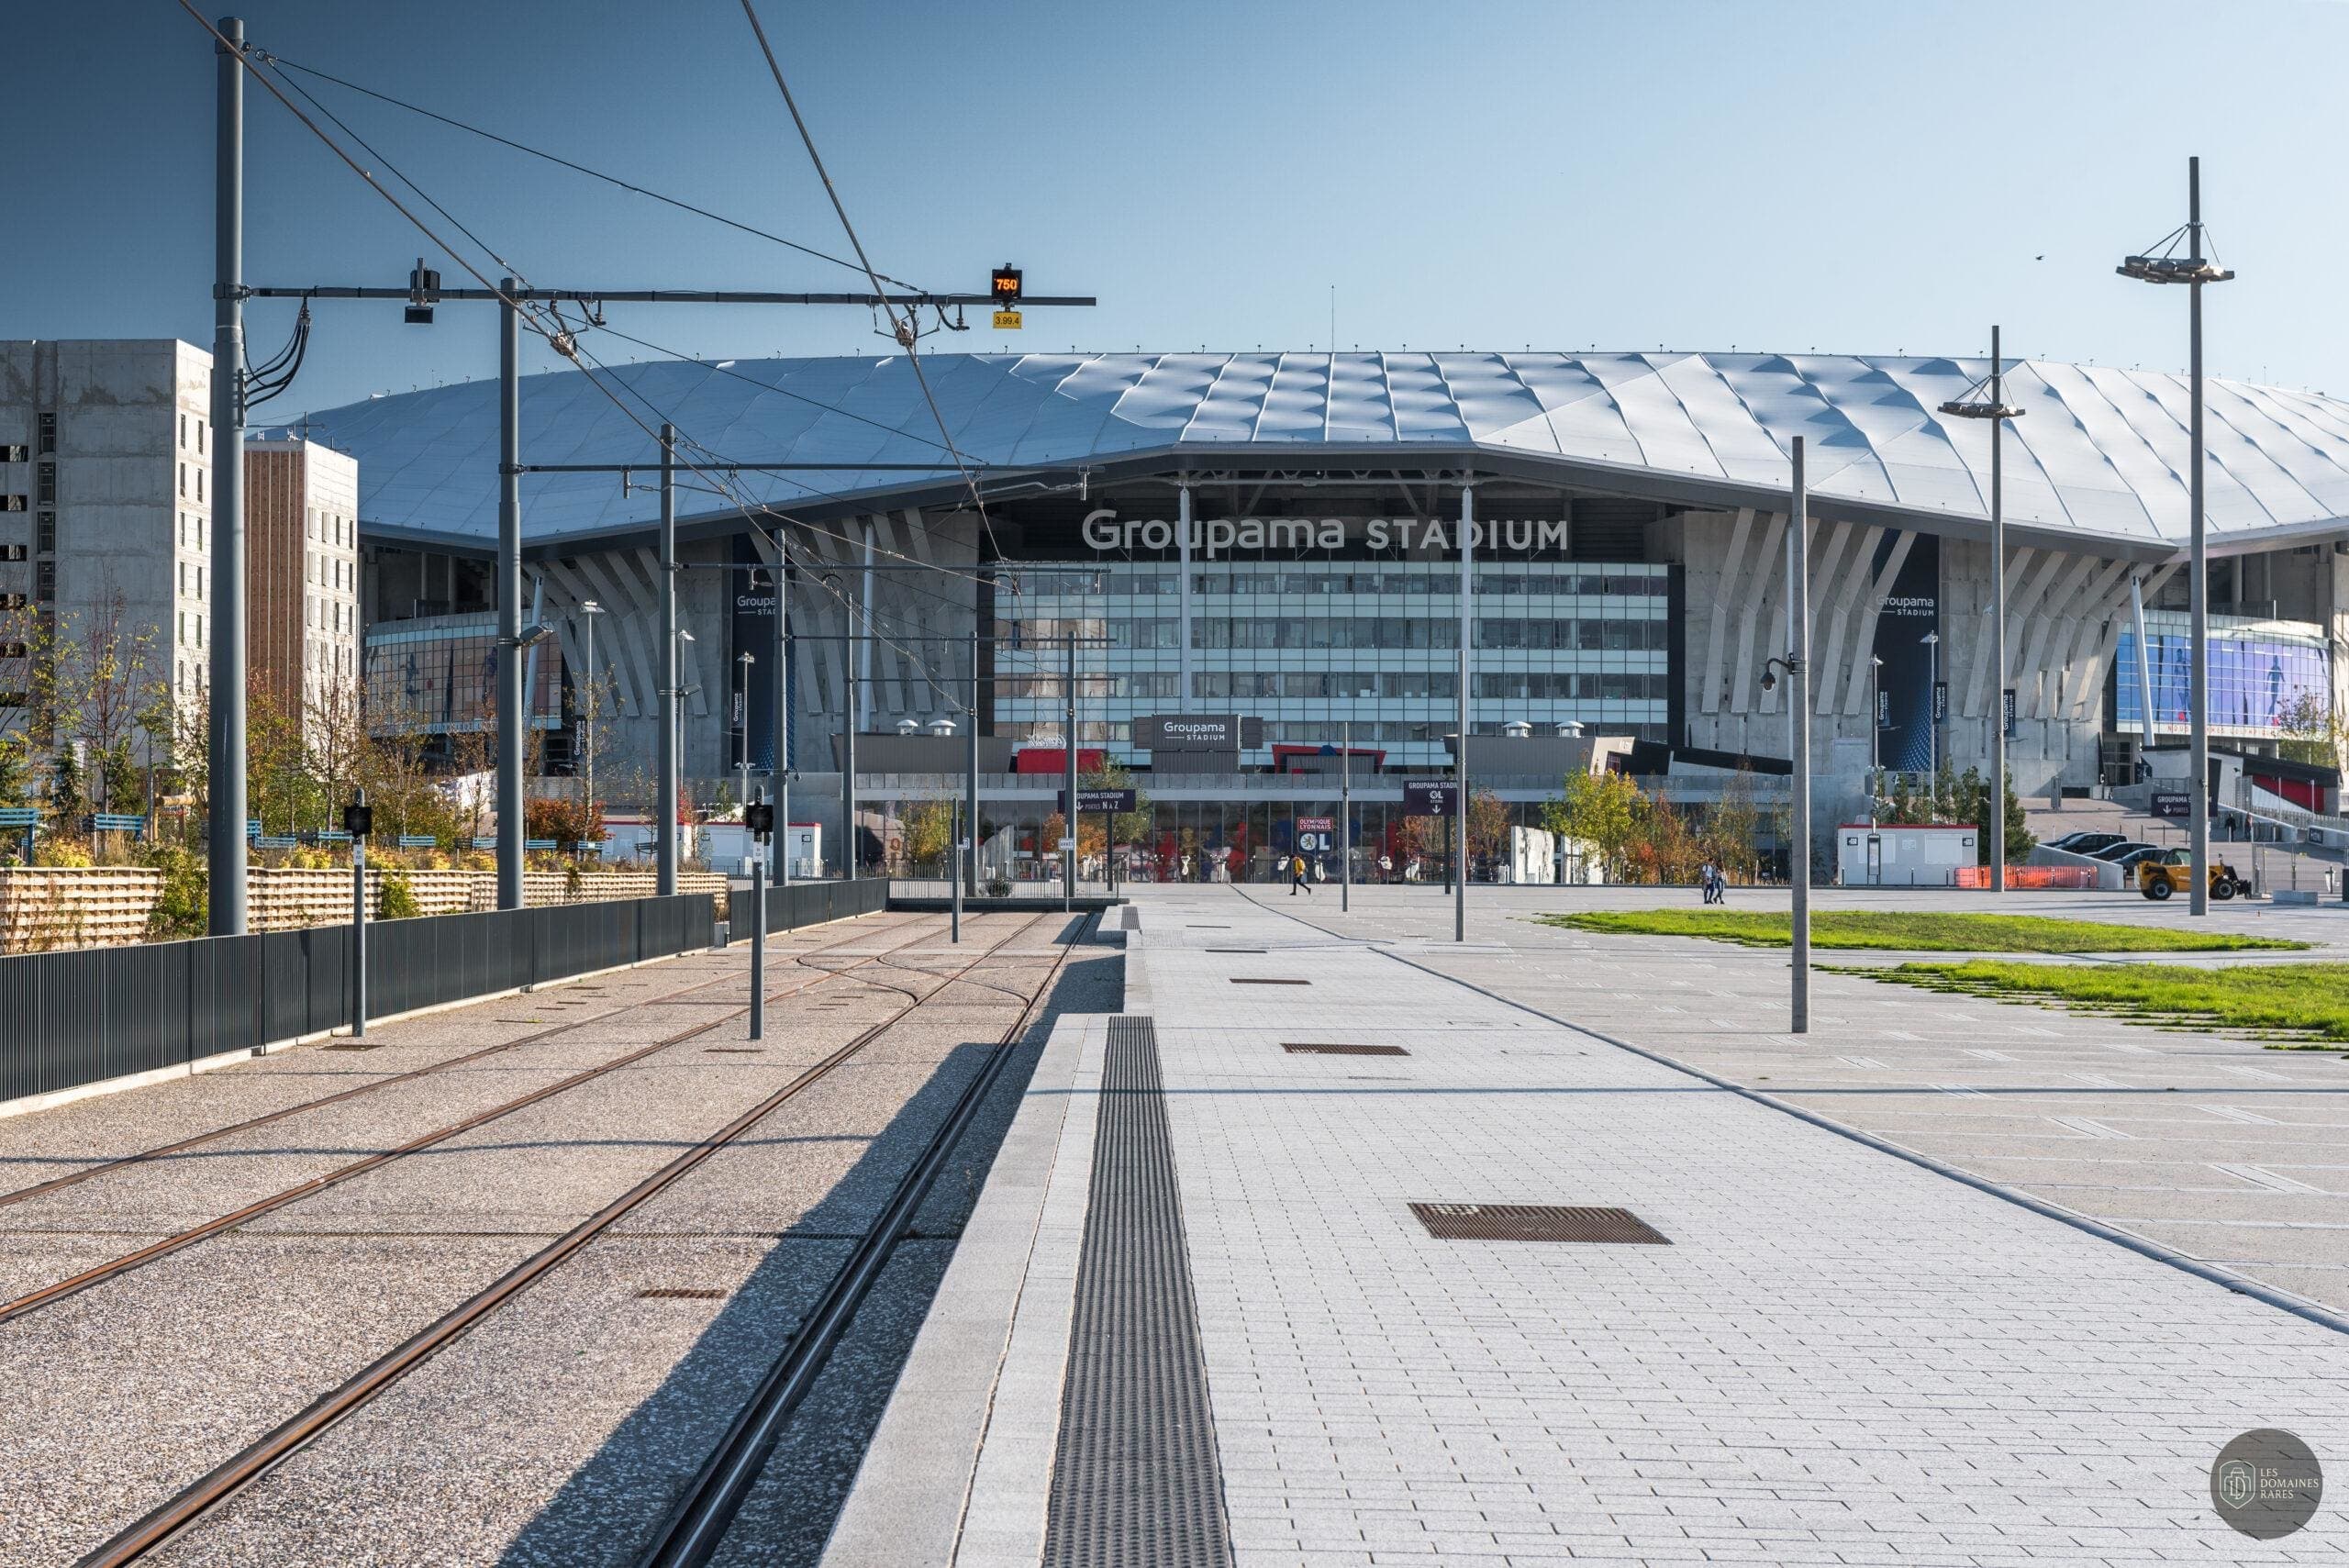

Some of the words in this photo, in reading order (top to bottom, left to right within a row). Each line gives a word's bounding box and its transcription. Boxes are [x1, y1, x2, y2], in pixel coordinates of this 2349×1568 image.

[996, 279, 1018, 291] 750
[1082, 509, 1345, 559] Groupama
[1365, 518, 1567, 550] STADIUM
[1876, 594, 1934, 608] Groupama
[1897, 608, 1934, 617] STADIUM
[1163, 721, 1226, 734] Groupama
[1076, 792, 1099, 800] OUPAMA
[1103, 801, 1108, 809] N
[1115, 801, 1119, 809] Z
